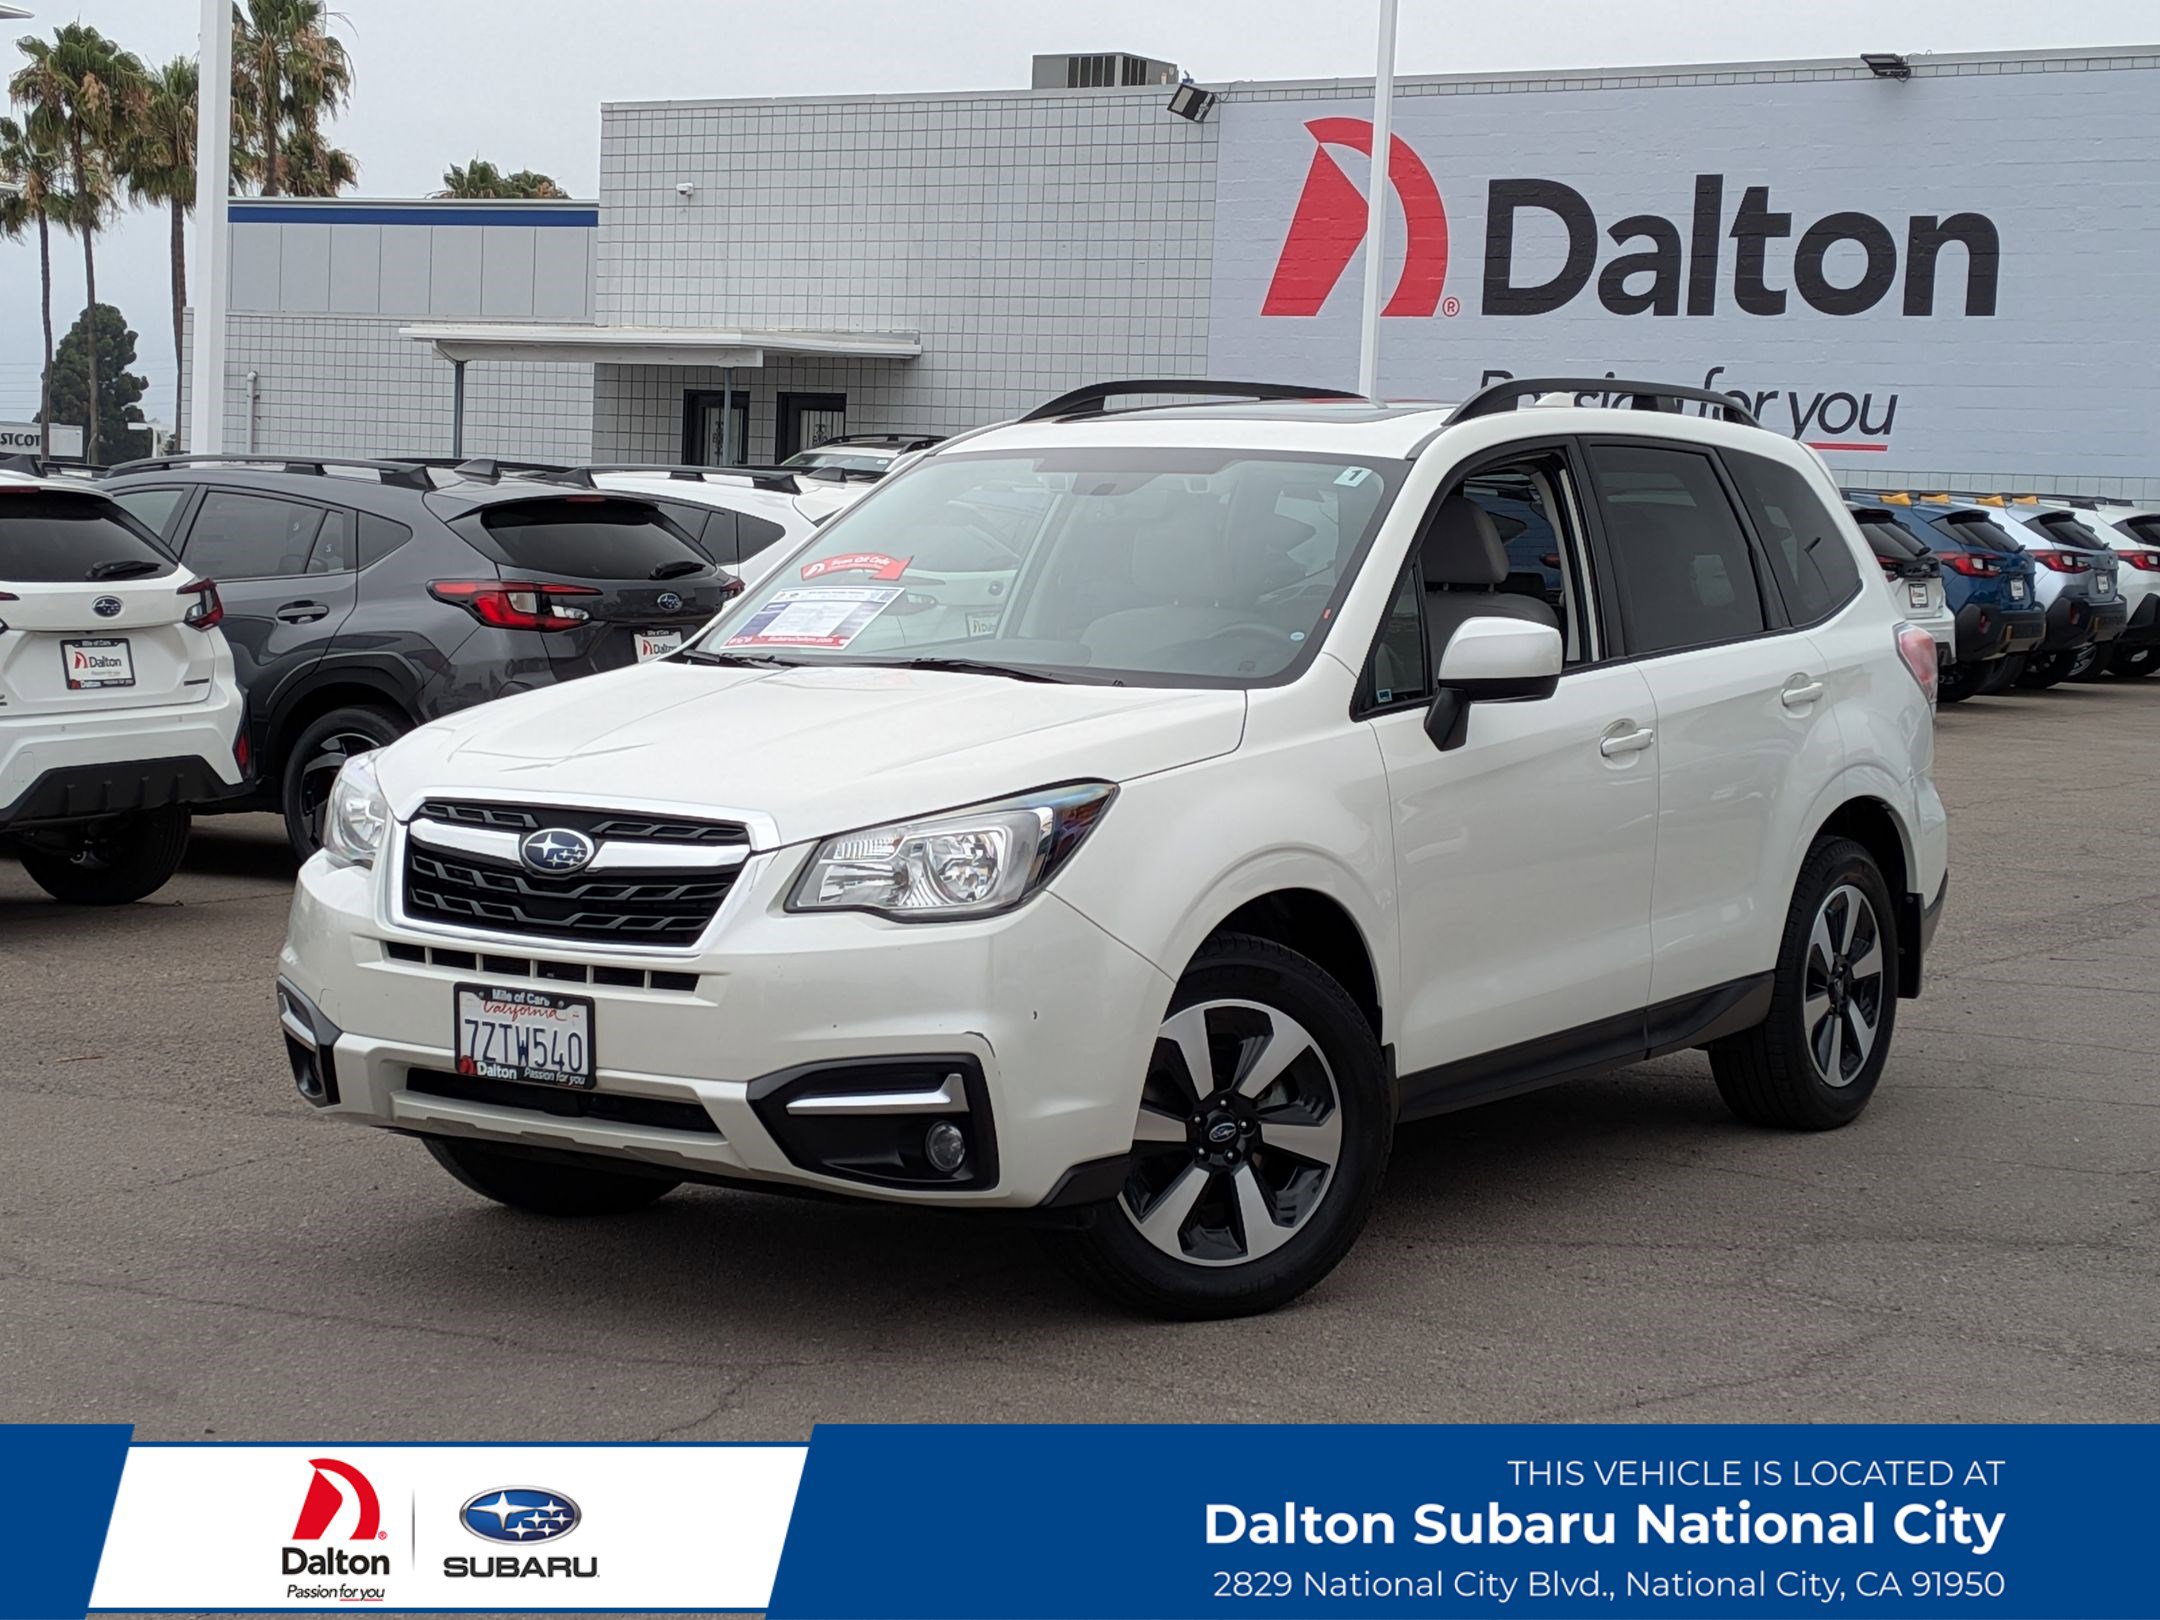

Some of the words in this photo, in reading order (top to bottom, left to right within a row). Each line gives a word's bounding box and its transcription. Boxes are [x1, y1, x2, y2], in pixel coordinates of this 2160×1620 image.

[1481, 173, 2000, 317] Dalton
[1788, 388, 1899, 440] you
[88, 656, 122, 668] Dalton
[492, 988, 513, 1001] Mile
[514, 990, 525, 1003] of
[526, 993, 551, 1006] Cars
[483, 1000, 567, 1022] California
[464, 1018, 583, 1073] 7ZTW540
[476, 1061, 518, 1081] Dalton
[523, 1067, 555, 1081] Passion
[556, 1071, 569, 1083] for
[569, 1075, 586, 1086] you
